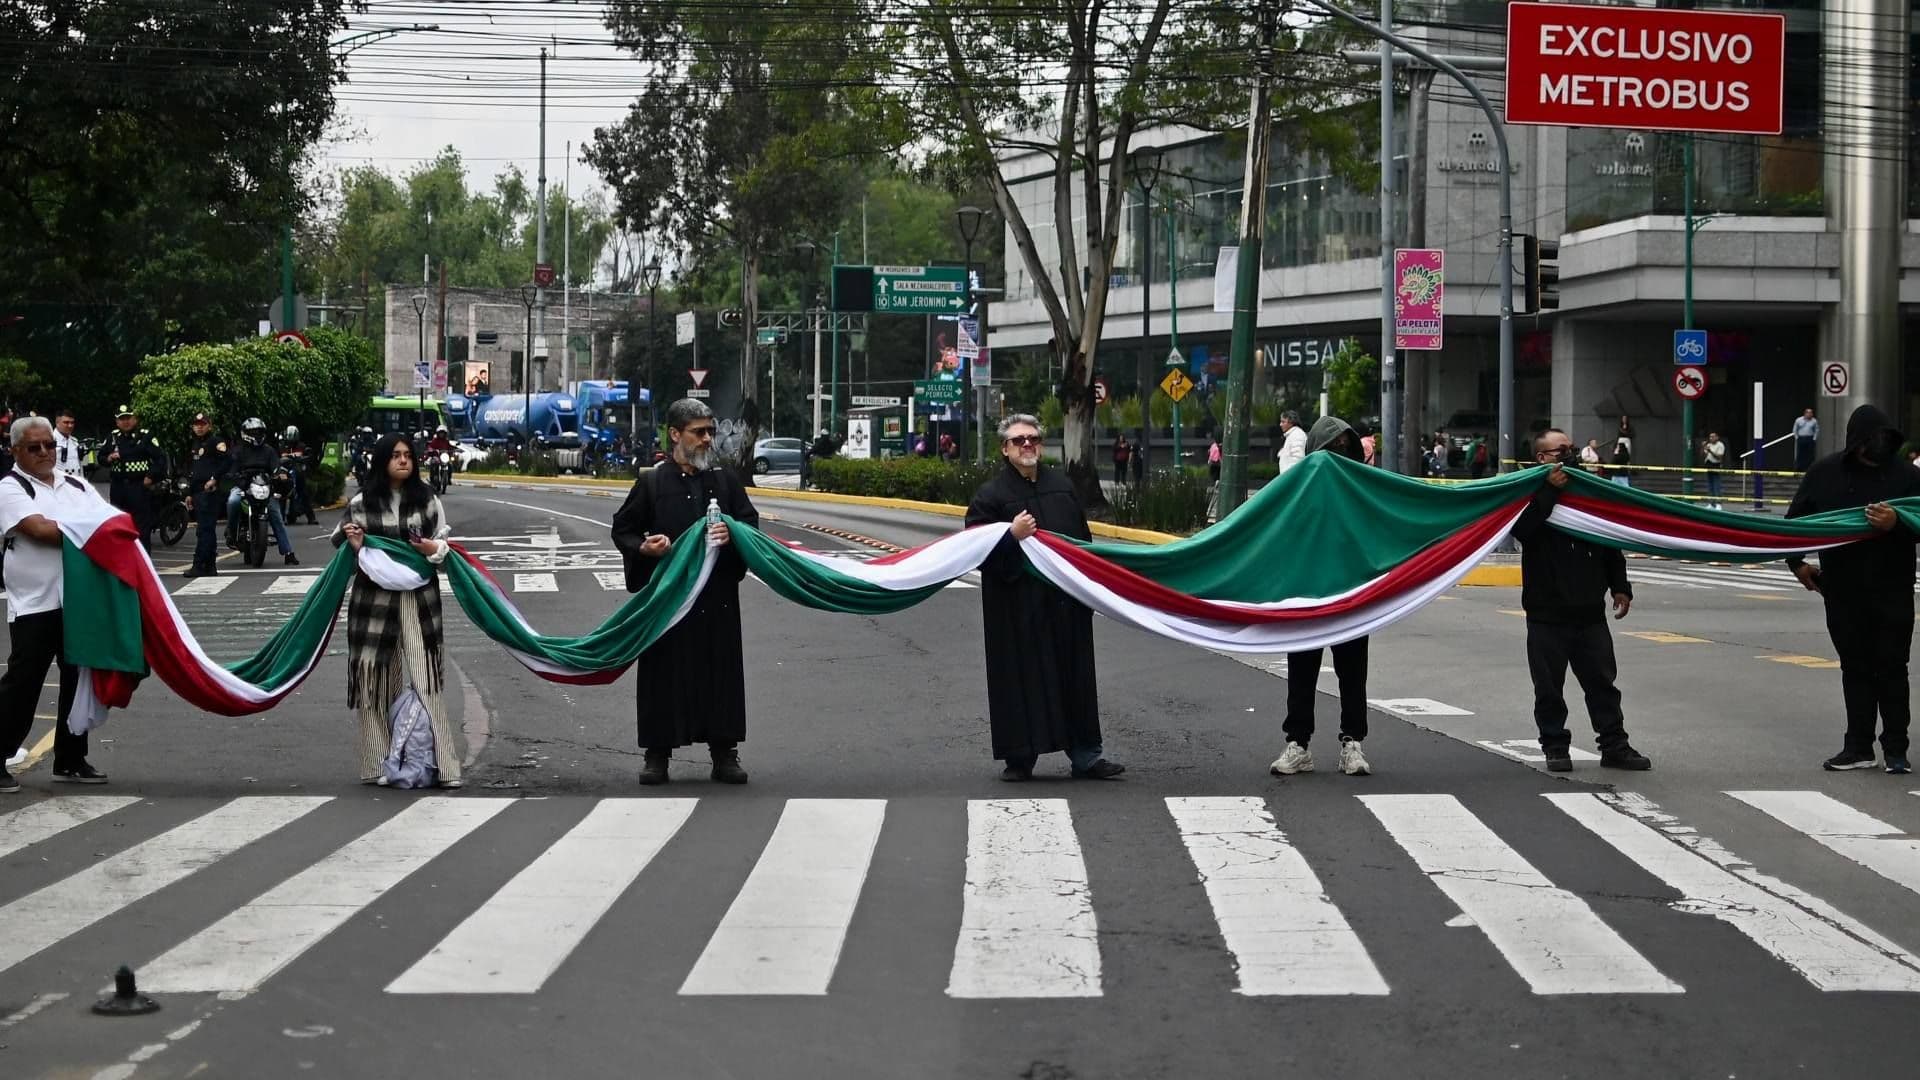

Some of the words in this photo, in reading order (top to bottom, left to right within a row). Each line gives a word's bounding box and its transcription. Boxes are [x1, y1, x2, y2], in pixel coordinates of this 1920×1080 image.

[1540, 24, 1753, 65] EXCLUSIVO
[1539, 73, 1750, 112] METROBUS
[877, 297, 888, 307] 10
[893, 296, 907, 307] SAN
[910, 296, 947, 308] JERONIMO
[1397, 319, 1407, 327] LA
[1408, 319, 1439, 328] PELOTA
[1264, 338, 1353, 368] NISSAN
[926, 391, 953, 399] PEDREGAL
